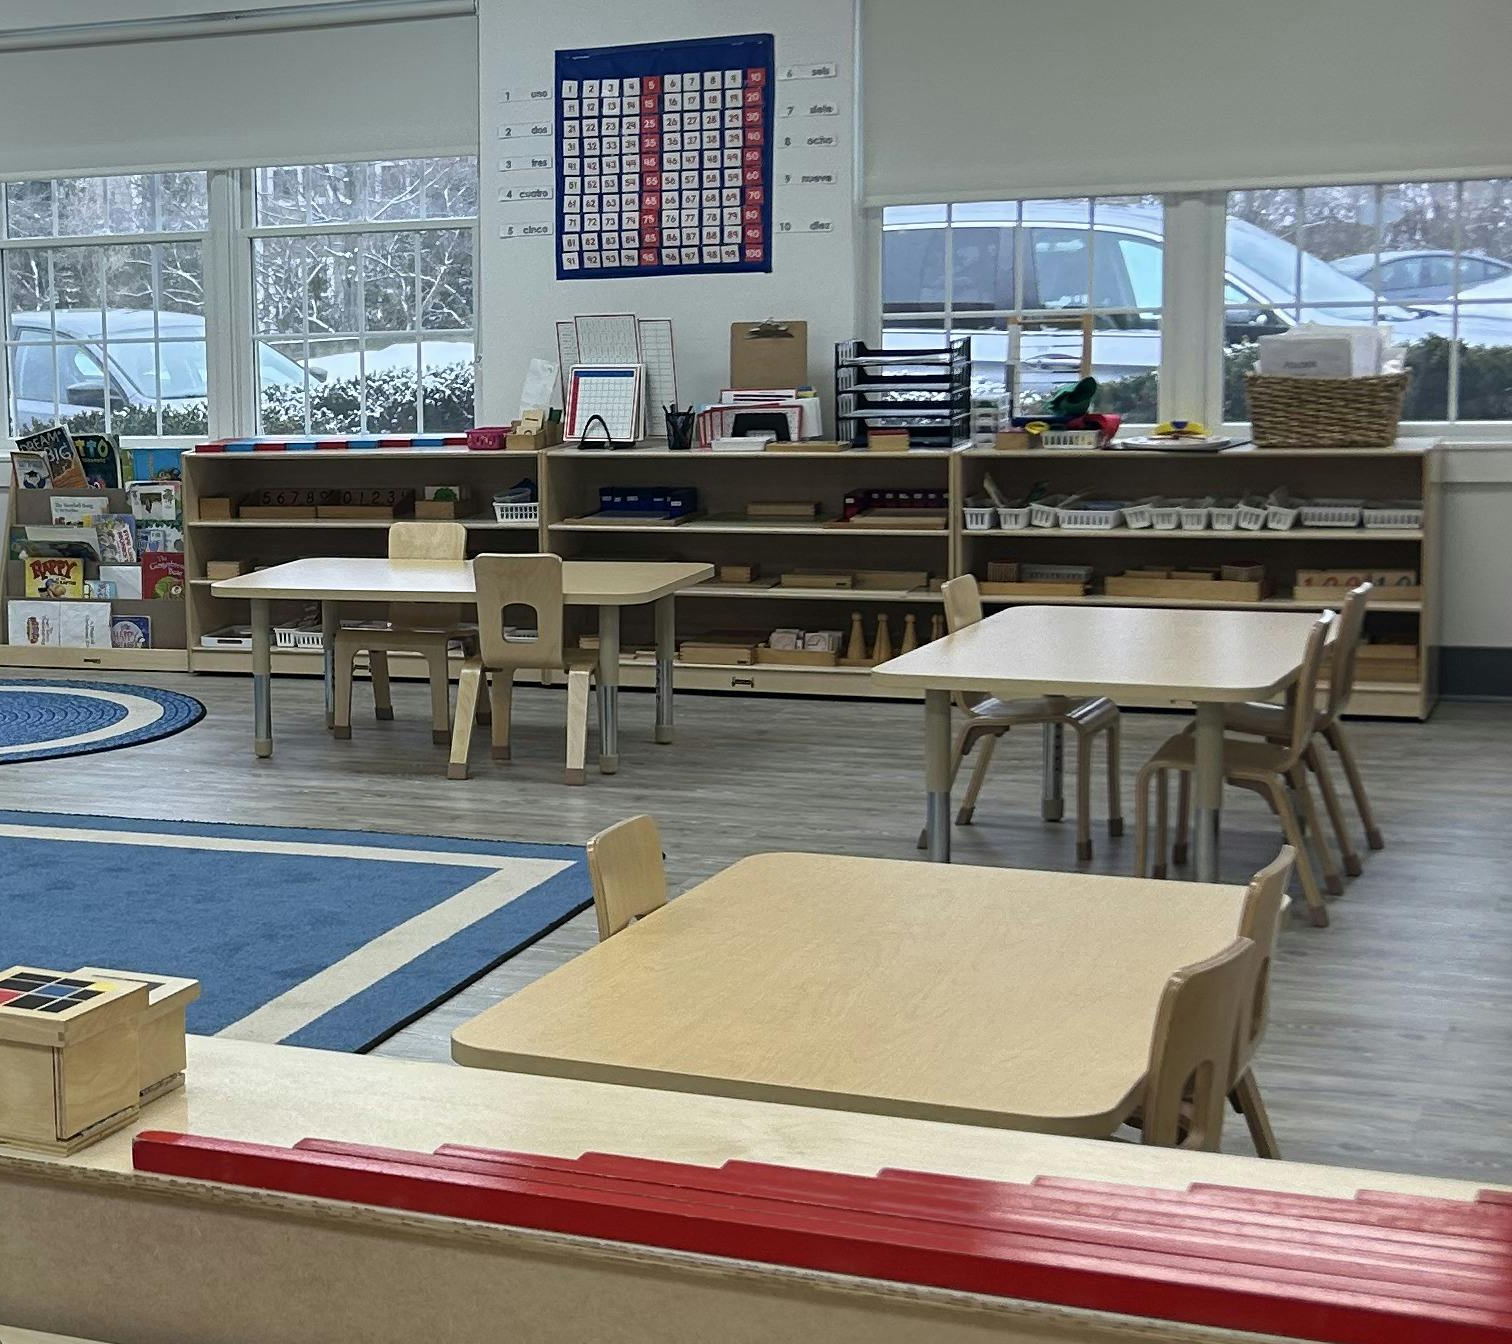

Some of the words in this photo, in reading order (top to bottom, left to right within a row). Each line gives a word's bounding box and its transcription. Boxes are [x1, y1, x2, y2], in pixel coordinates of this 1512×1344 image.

[787, 70, 792, 78] 6
[812, 67, 830, 76] seis
[589, 84, 594, 93] 2
[608, 84, 613, 92] 3
[670, 80, 676, 88] 6
[689, 78, 695, 86] 7
[506, 92, 510, 100] 1
[587, 103, 595, 111] 12
[608, 102, 616, 110] 13
[669, 98, 678, 106] 16
[688, 96, 696, 104] 17
[788, 106, 794, 116] 7
[506, 128, 511, 136] 2
[532, 126, 547, 134] dos
[568, 125, 576, 133] 21
[586, 124, 595, 132] 22
[606, 122, 616, 130] 23
[644, 120, 655, 128] 25
[666, 118, 678, 126] 26
[687, 117, 697, 125] 27
[587, 142, 597, 150] 32
[687, 136, 697, 145] 37
[784, 137, 791, 146] 8
[506, 160, 511, 168] 3
[532, 158, 547, 167] tres
[587, 162, 597, 170] 42
[686, 156, 696, 164] 47
[685, 176, 696, 184] 57
[728, 173, 739, 182] 59
[746, 171, 759, 180] 60
[785, 175, 790, 184] 9
[506, 190, 512, 198] 4
[520, 190, 548, 198] cuatro
[586, 199, 595, 208] 62
[606, 199, 616, 207] 63
[685, 195, 696, 203] 67
[705, 194, 716, 202] 68
[726, 193, 737, 201] 69
[748, 191, 760, 199] 70
[568, 219, 576, 227] 71
[587, 218, 597, 226] 72
[606, 218, 615, 226] 73
[666, 215, 676, 223] 76
[685, 214, 695, 222] 77
[728, 212, 738, 220] 79
[508, 226, 513, 235] 5
[523, 226, 548, 234] cinco
[780, 222, 791, 231] 10
[810, 222, 830, 230] diez
[686, 232, 696, 241] 87
[606, 255, 616, 263] 93
[666, 253, 676, 261] 96
[685, 252, 695, 260] 97
[746, 249, 762, 257] 100
[20, 430, 59, 451] DREAM
[44, 446, 72, 464] BIG
[277, 491, 285, 504] 6
[289, 491, 299, 504] 7
[306, 491, 314, 504] 8
[343, 491, 352, 504] 0
[371, 491, 381, 504] 2
[386, 490, 395, 504] 3
